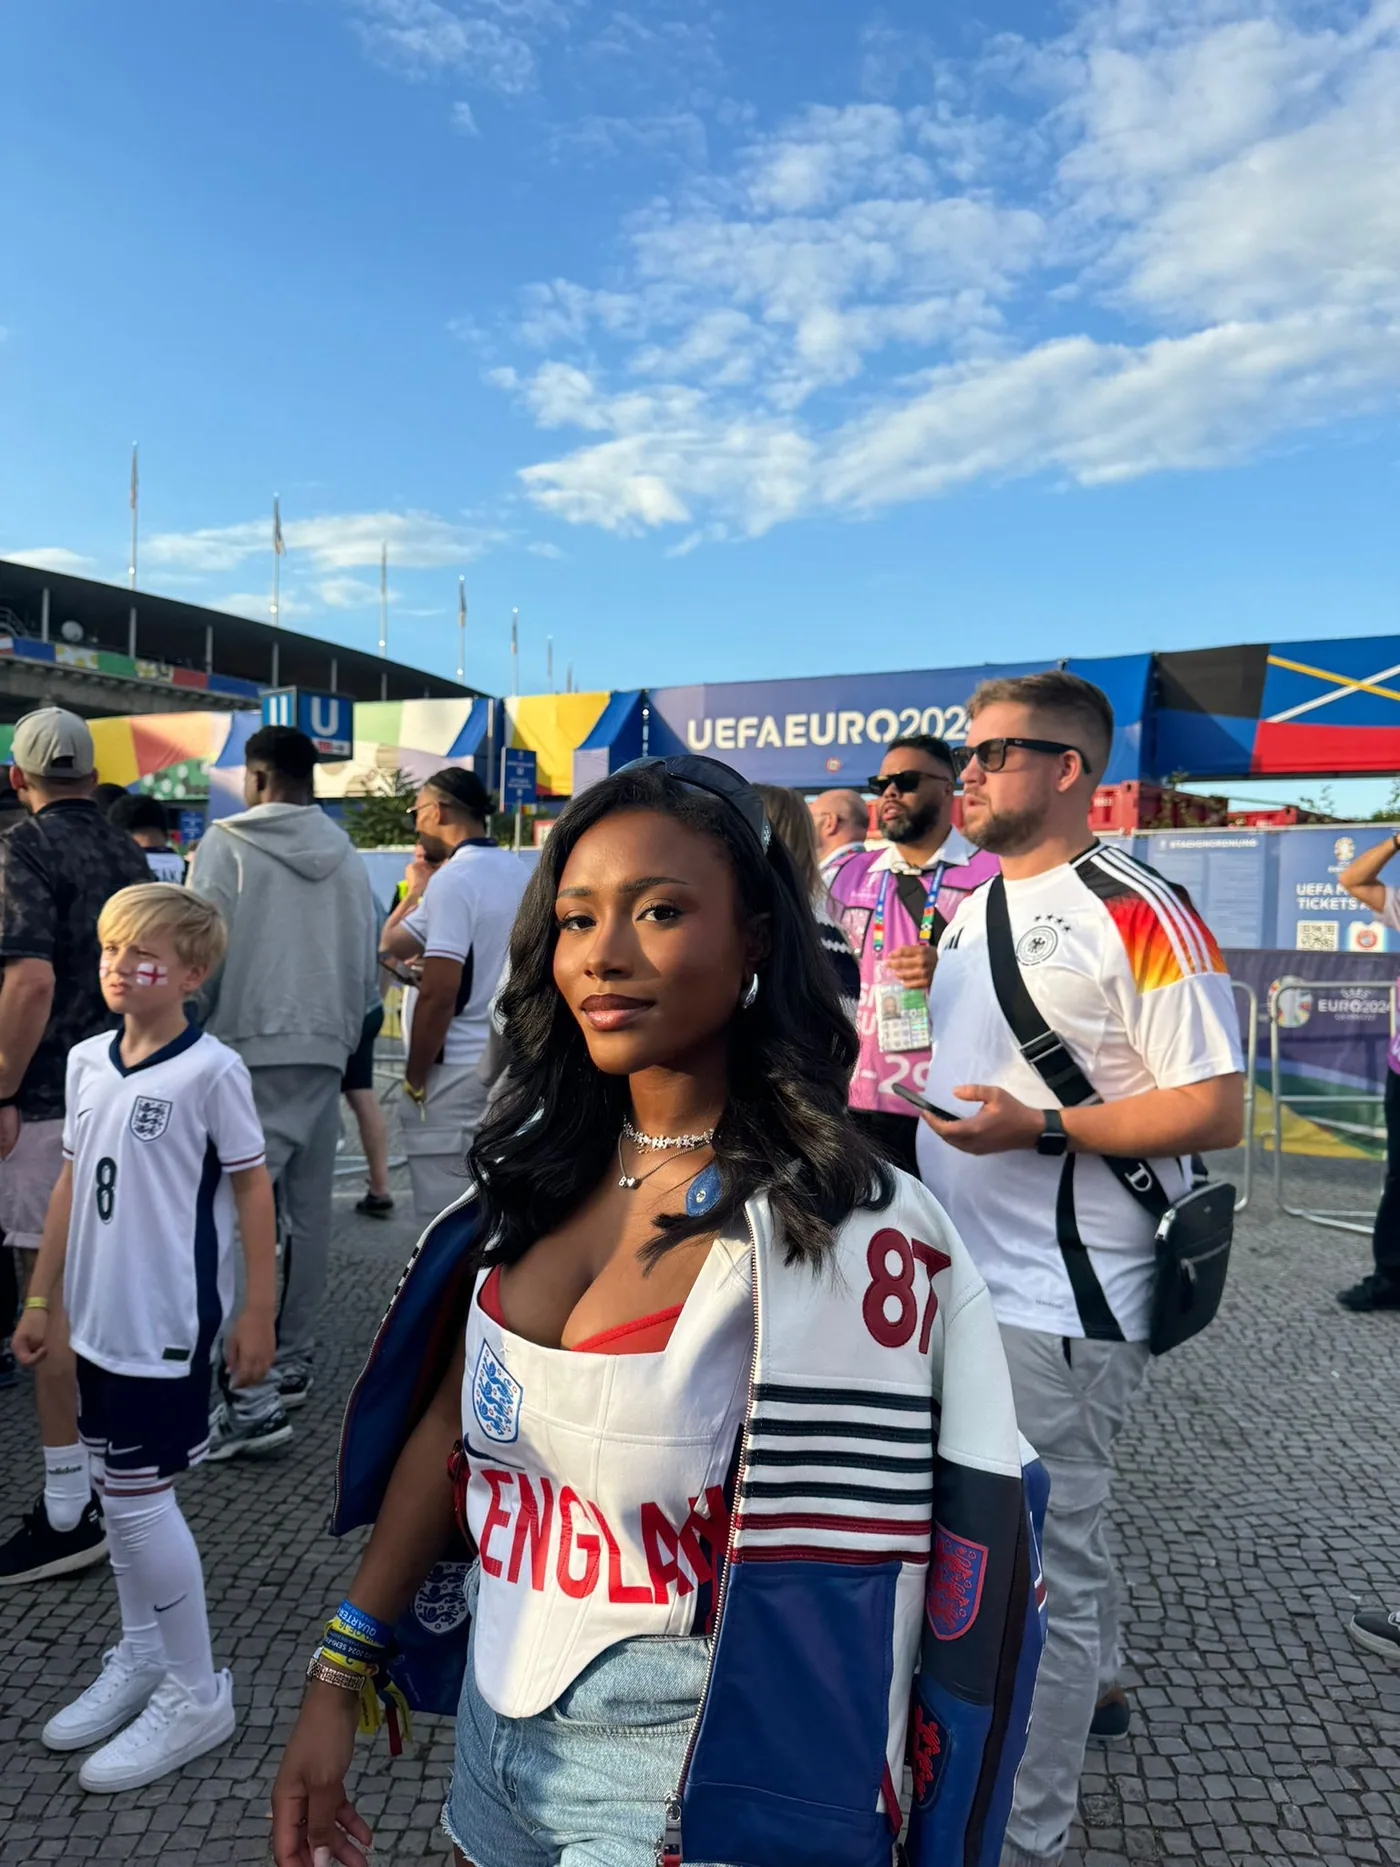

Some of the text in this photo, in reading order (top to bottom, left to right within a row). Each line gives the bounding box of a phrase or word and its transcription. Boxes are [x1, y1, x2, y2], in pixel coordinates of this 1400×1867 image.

[310, 696, 340, 737] U
[1296, 882, 1333, 896] UEFA
[1297, 896, 1358, 911] TICKETS
[96, 1156, 117, 1225] 8
